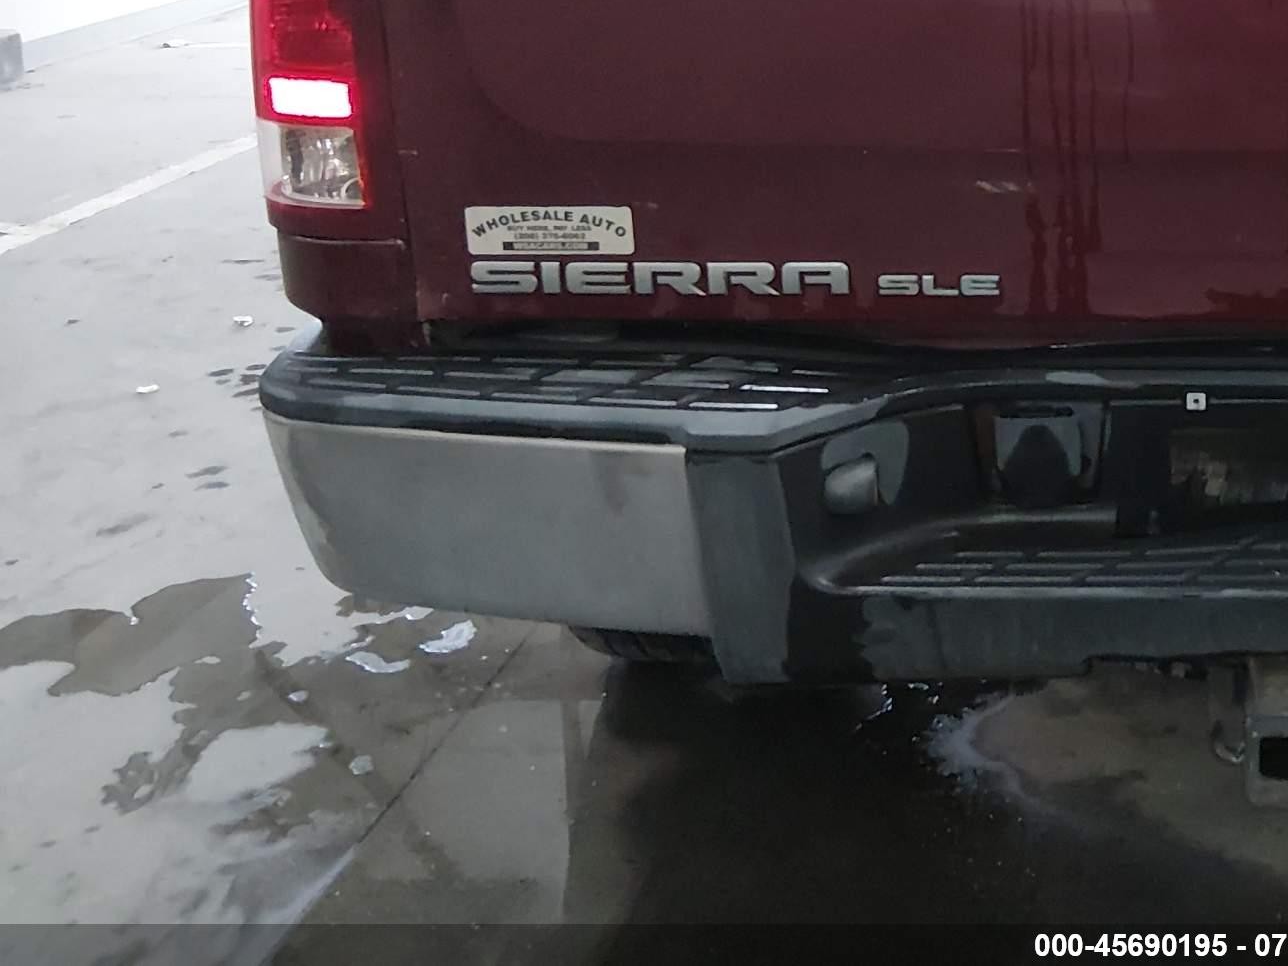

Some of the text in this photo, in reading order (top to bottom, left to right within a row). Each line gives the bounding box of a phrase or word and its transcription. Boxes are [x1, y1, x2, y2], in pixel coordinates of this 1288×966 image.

[472, 210, 627, 237] WHOLESALE AUTO
[471, 261, 999, 296] SIERRA SLE
